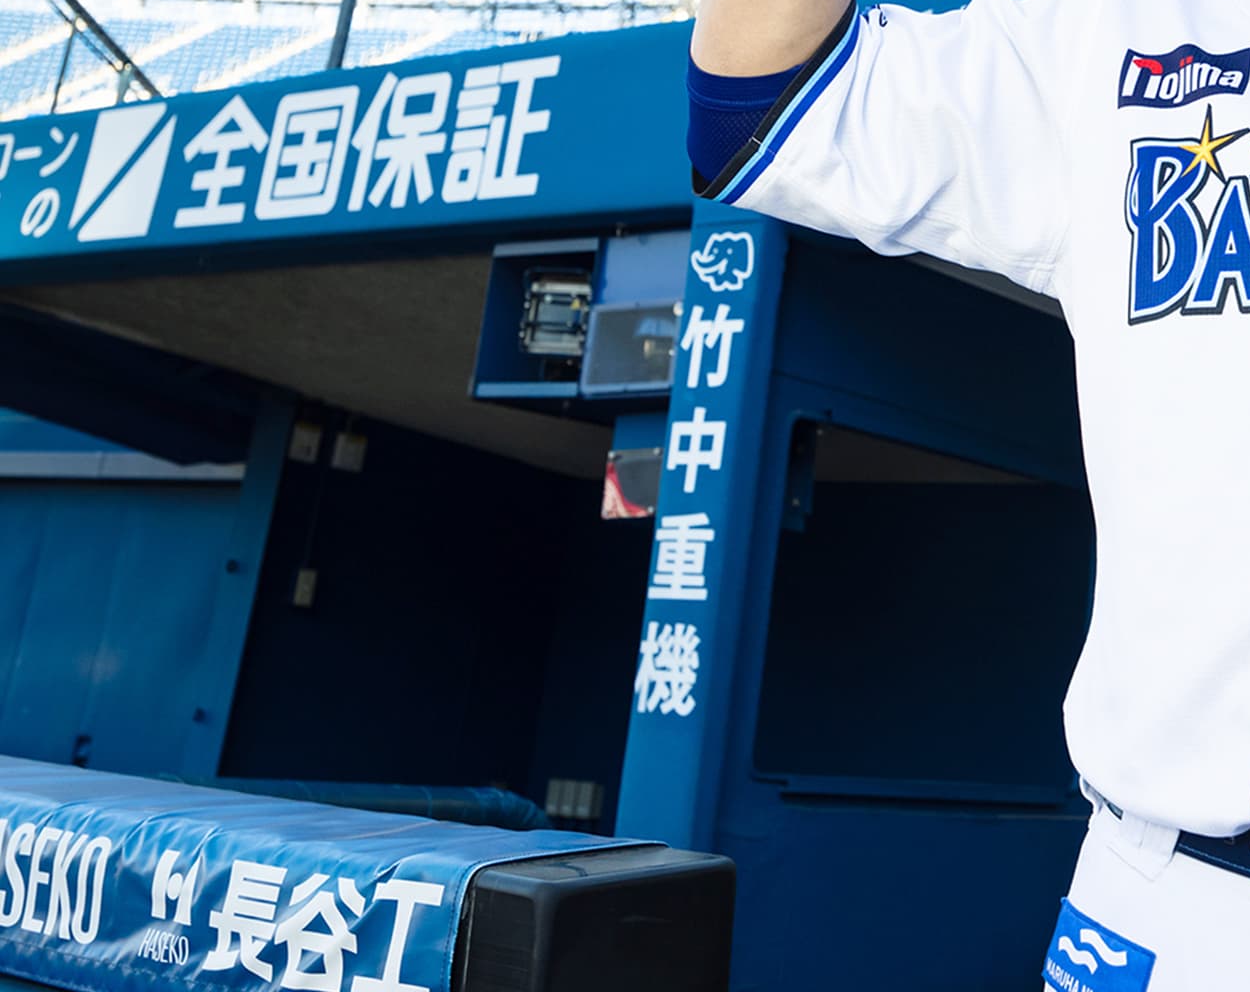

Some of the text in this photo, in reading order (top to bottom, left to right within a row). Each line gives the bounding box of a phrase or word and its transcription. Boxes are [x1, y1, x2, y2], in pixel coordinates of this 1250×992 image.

[173, 55, 561, 229] 全国保証
[634, 304, 745, 717] 竹中重機
[0, 819, 112, 945] SEKO
[138, 928, 189, 965] HASEKO
[202, 860, 445, 992] 長谷工
